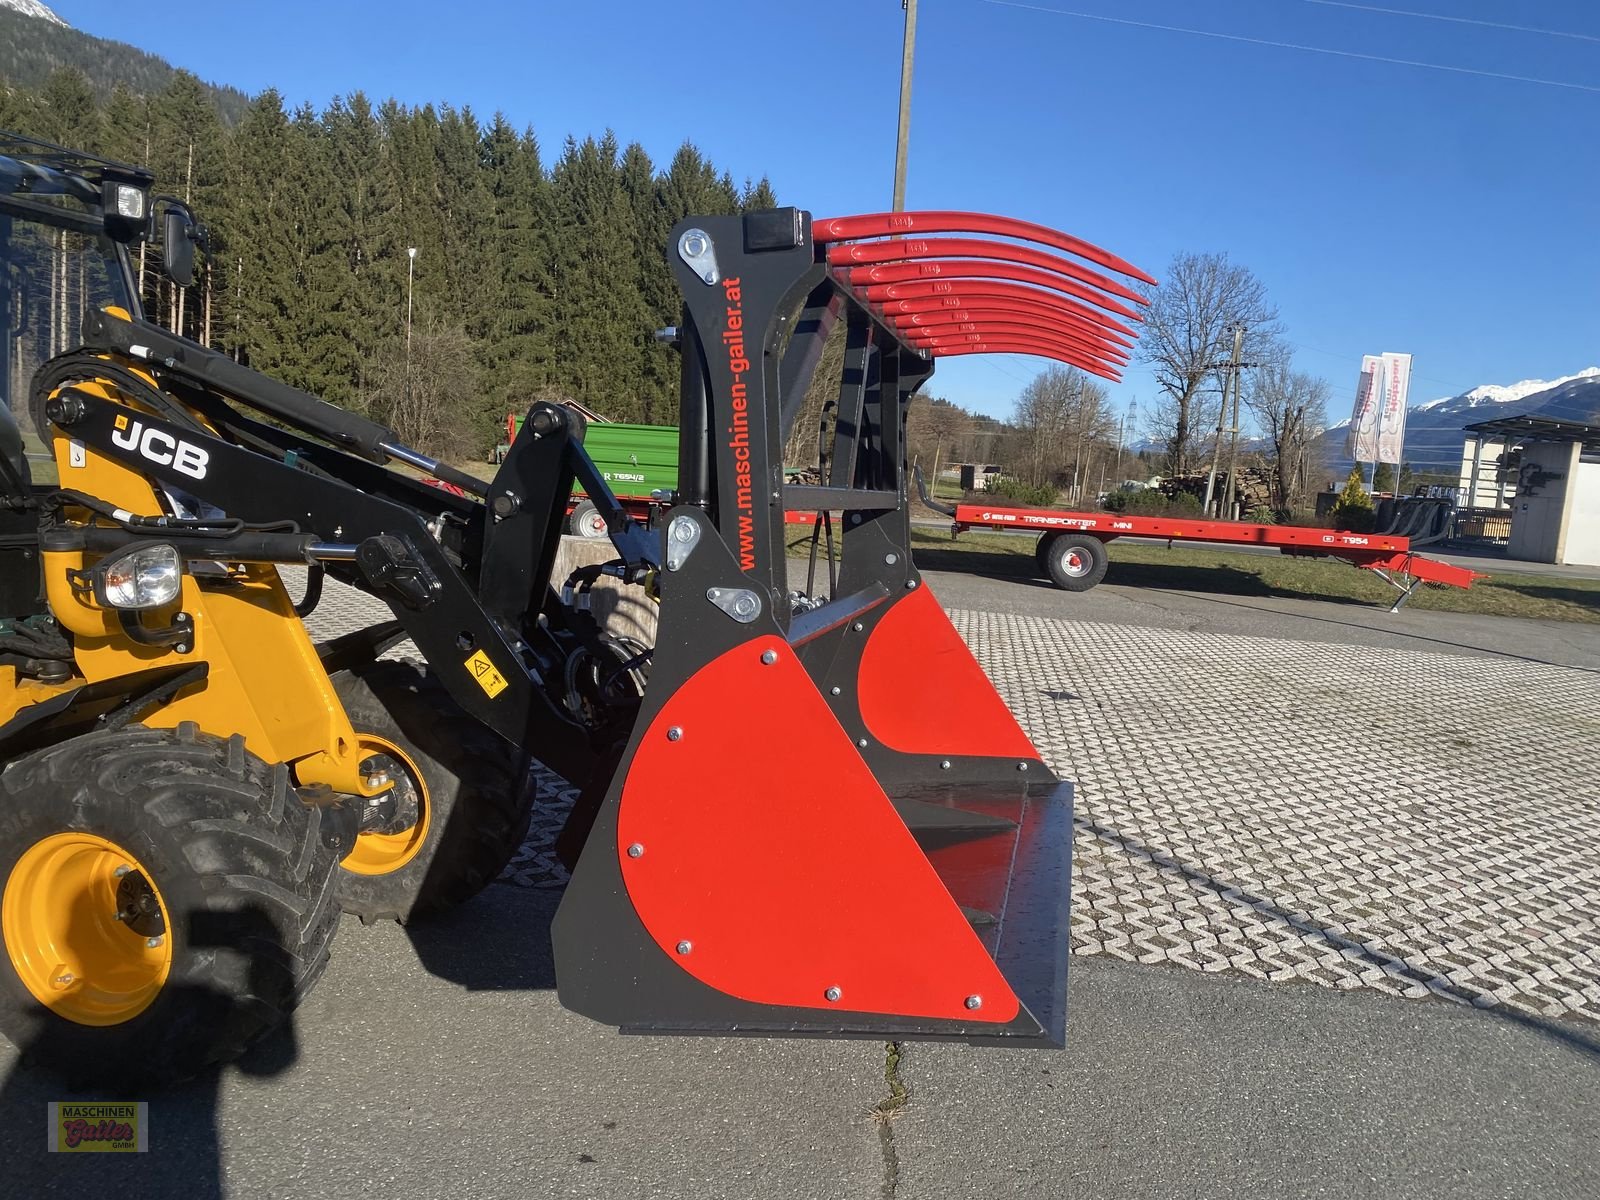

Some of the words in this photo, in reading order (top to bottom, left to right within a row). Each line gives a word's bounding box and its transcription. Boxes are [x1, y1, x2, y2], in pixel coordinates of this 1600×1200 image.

[723, 277, 755, 571] www.maschinen-gailer.at
[112, 420, 209, 480] JCB
[1023, 515, 1097, 527] TRANSPORTER
[1113, 521, 1133, 529] MINI
[1342, 536, 1369, 545] T954
